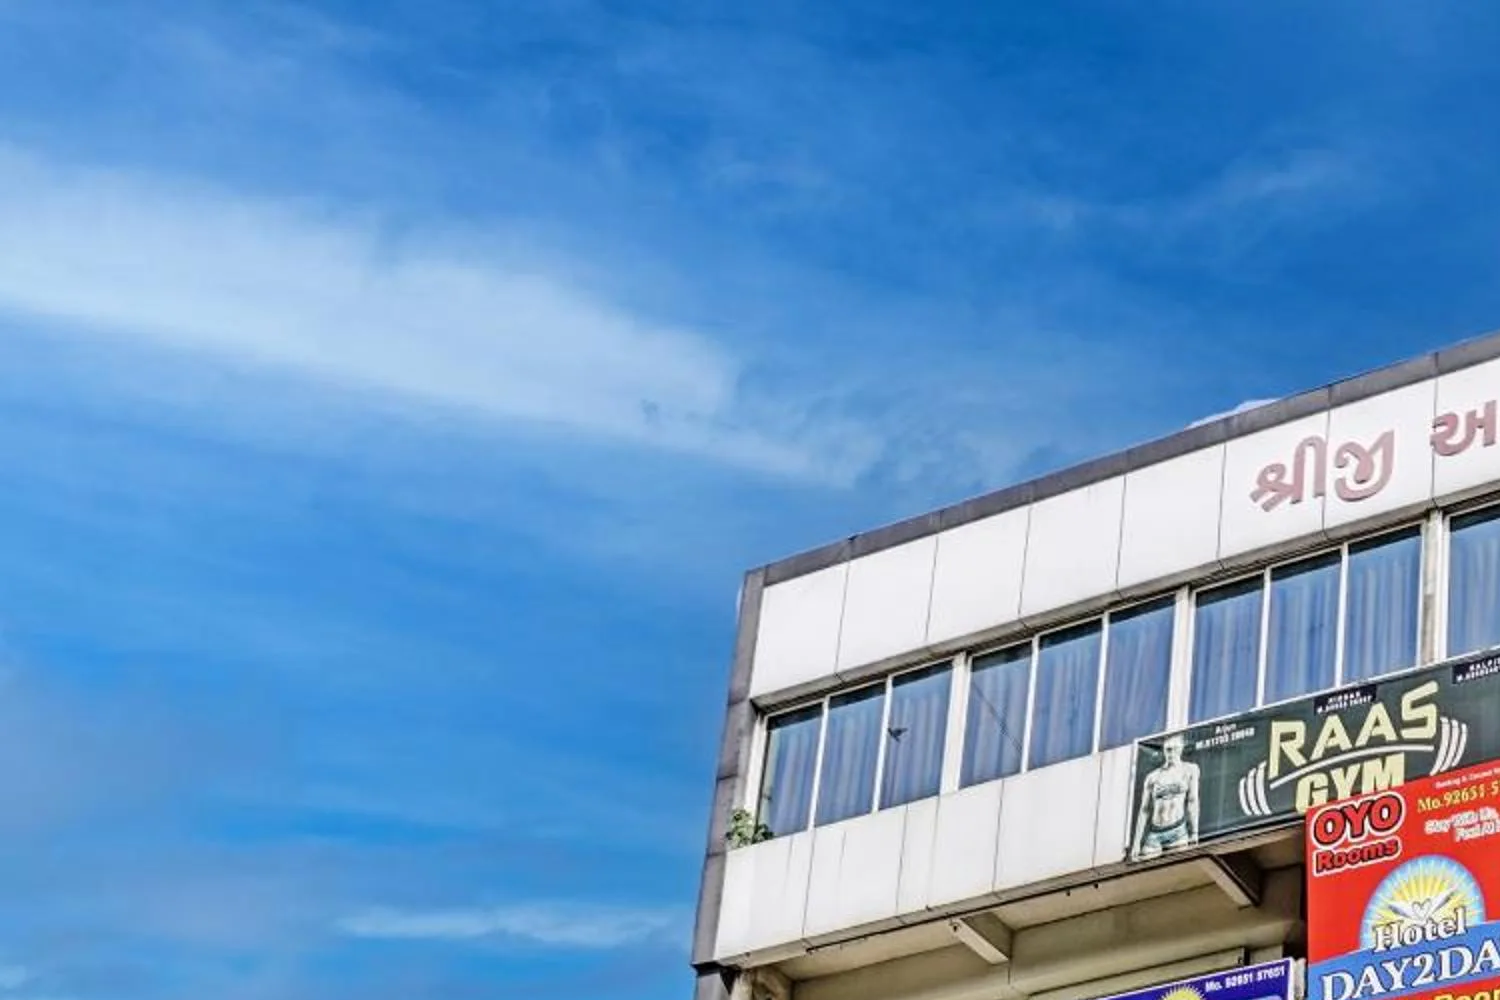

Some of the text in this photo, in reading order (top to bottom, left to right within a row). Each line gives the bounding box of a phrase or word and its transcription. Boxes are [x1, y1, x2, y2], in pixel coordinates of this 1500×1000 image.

[1250, 428, 1395, 513] શ્રીજી
[1269, 681, 1440, 779] RAAS
[1295, 748, 1406, 813] GYM
[1313, 796, 1403, 845] OYO
[1316, 839, 1399, 873] Rooms
[1374, 907, 1468, 951] Hotel
